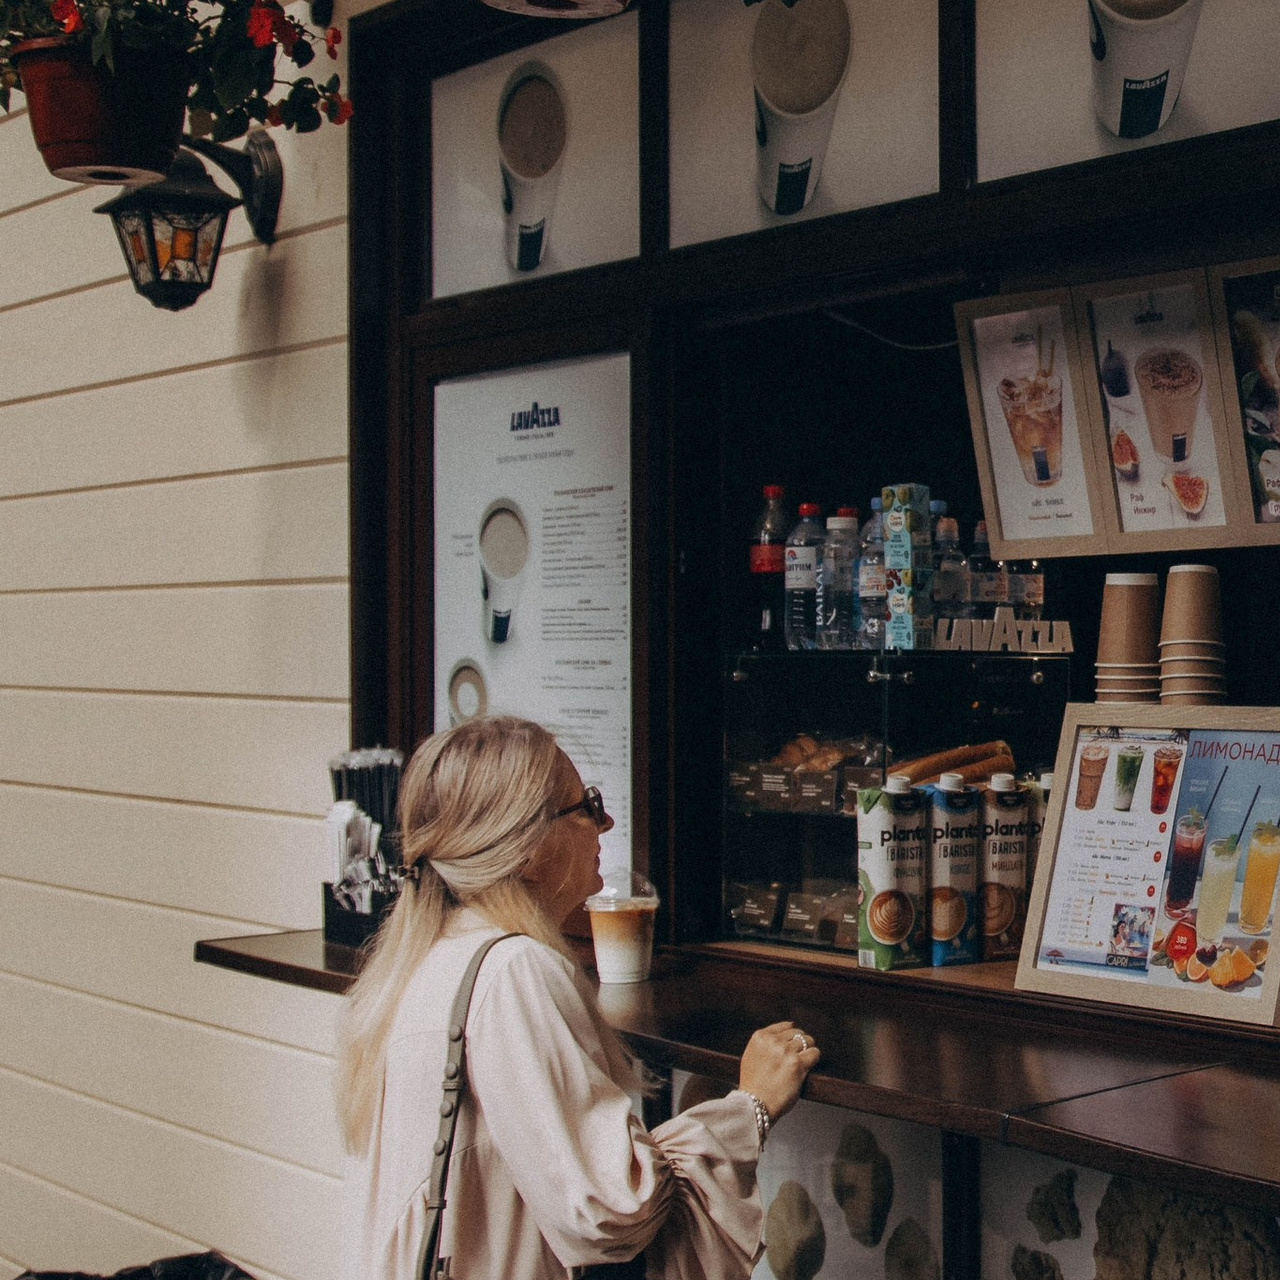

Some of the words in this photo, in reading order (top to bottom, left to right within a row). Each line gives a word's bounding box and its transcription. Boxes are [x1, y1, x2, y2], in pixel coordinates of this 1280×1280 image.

[1125, 74, 1167, 90] LAVAZZA
[510, 402, 561, 431] LAVAZZA
[936, 607, 1074, 652] LAVAZZA
[1106, 954, 1129, 967] CAPRI
